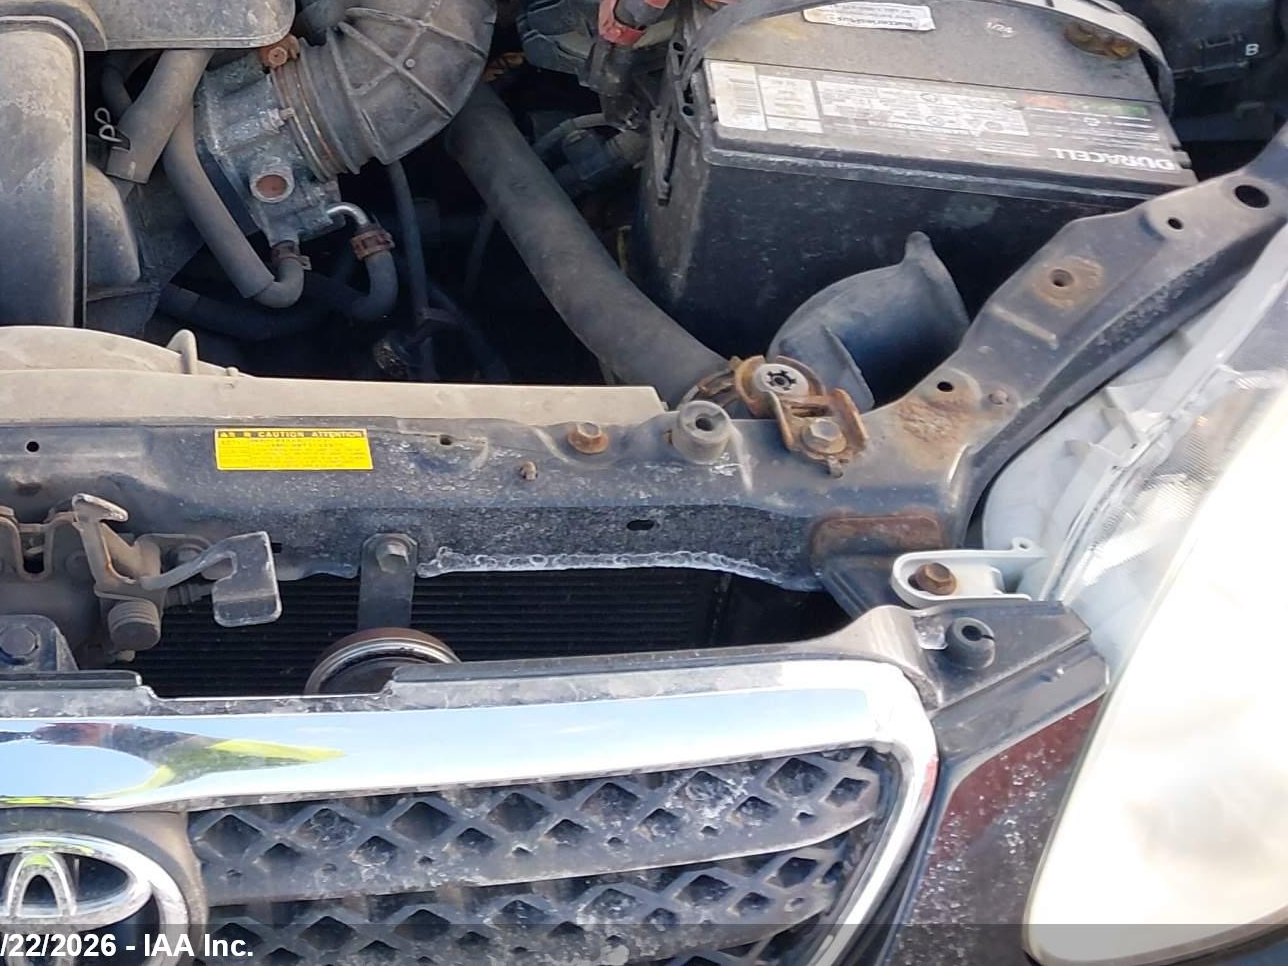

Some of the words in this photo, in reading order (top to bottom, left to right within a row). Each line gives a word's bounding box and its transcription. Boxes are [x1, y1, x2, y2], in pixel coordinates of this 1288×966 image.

[1245, 43, 1260, 56] B
[1047, 147, 1176, 171] DURACELL
[257, 430, 305, 439] CAUTION
